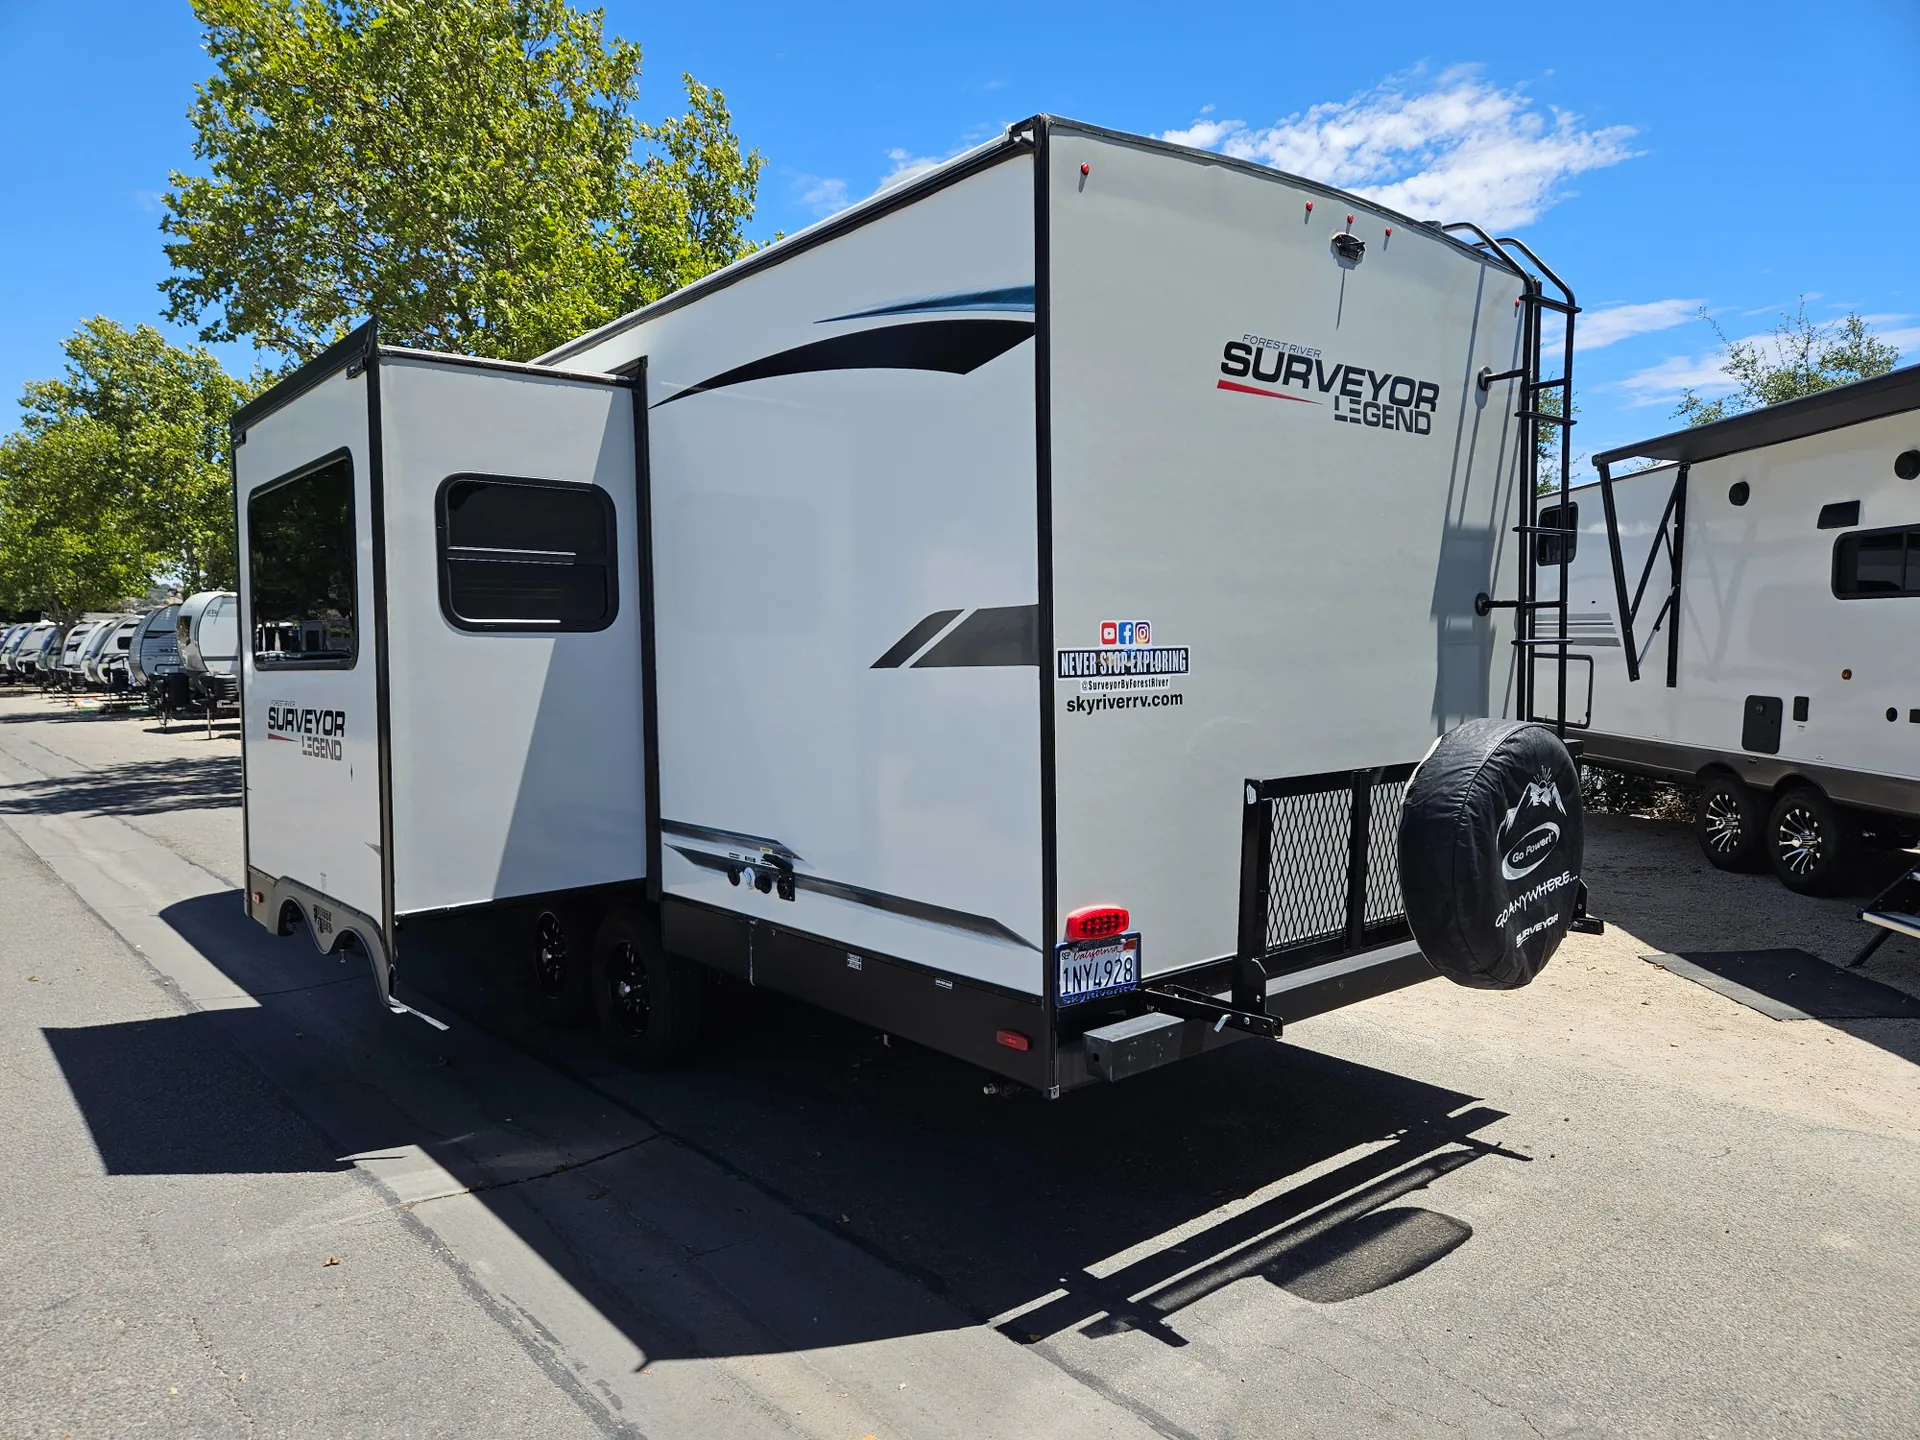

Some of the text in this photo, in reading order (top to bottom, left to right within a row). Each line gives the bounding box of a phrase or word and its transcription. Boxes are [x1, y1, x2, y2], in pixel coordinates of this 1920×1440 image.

[1242, 334, 1322, 358] FOREST RIVER
[1220, 340, 1440, 412] SURVEYOR
[1334, 395, 1432, 435] LEGEND
[1061, 649, 1187, 676] NEVER STOP EXPLORING
[1066, 693, 1183, 715] skyriverrv.com
[268, 706, 345, 737] SURVEYOR
[302, 735, 342, 761] LEGEND
[1512, 851, 1525, 864] Go
[1516, 913, 1559, 945] SURVEYOR
[1062, 956, 1133, 995] 1NY4928
